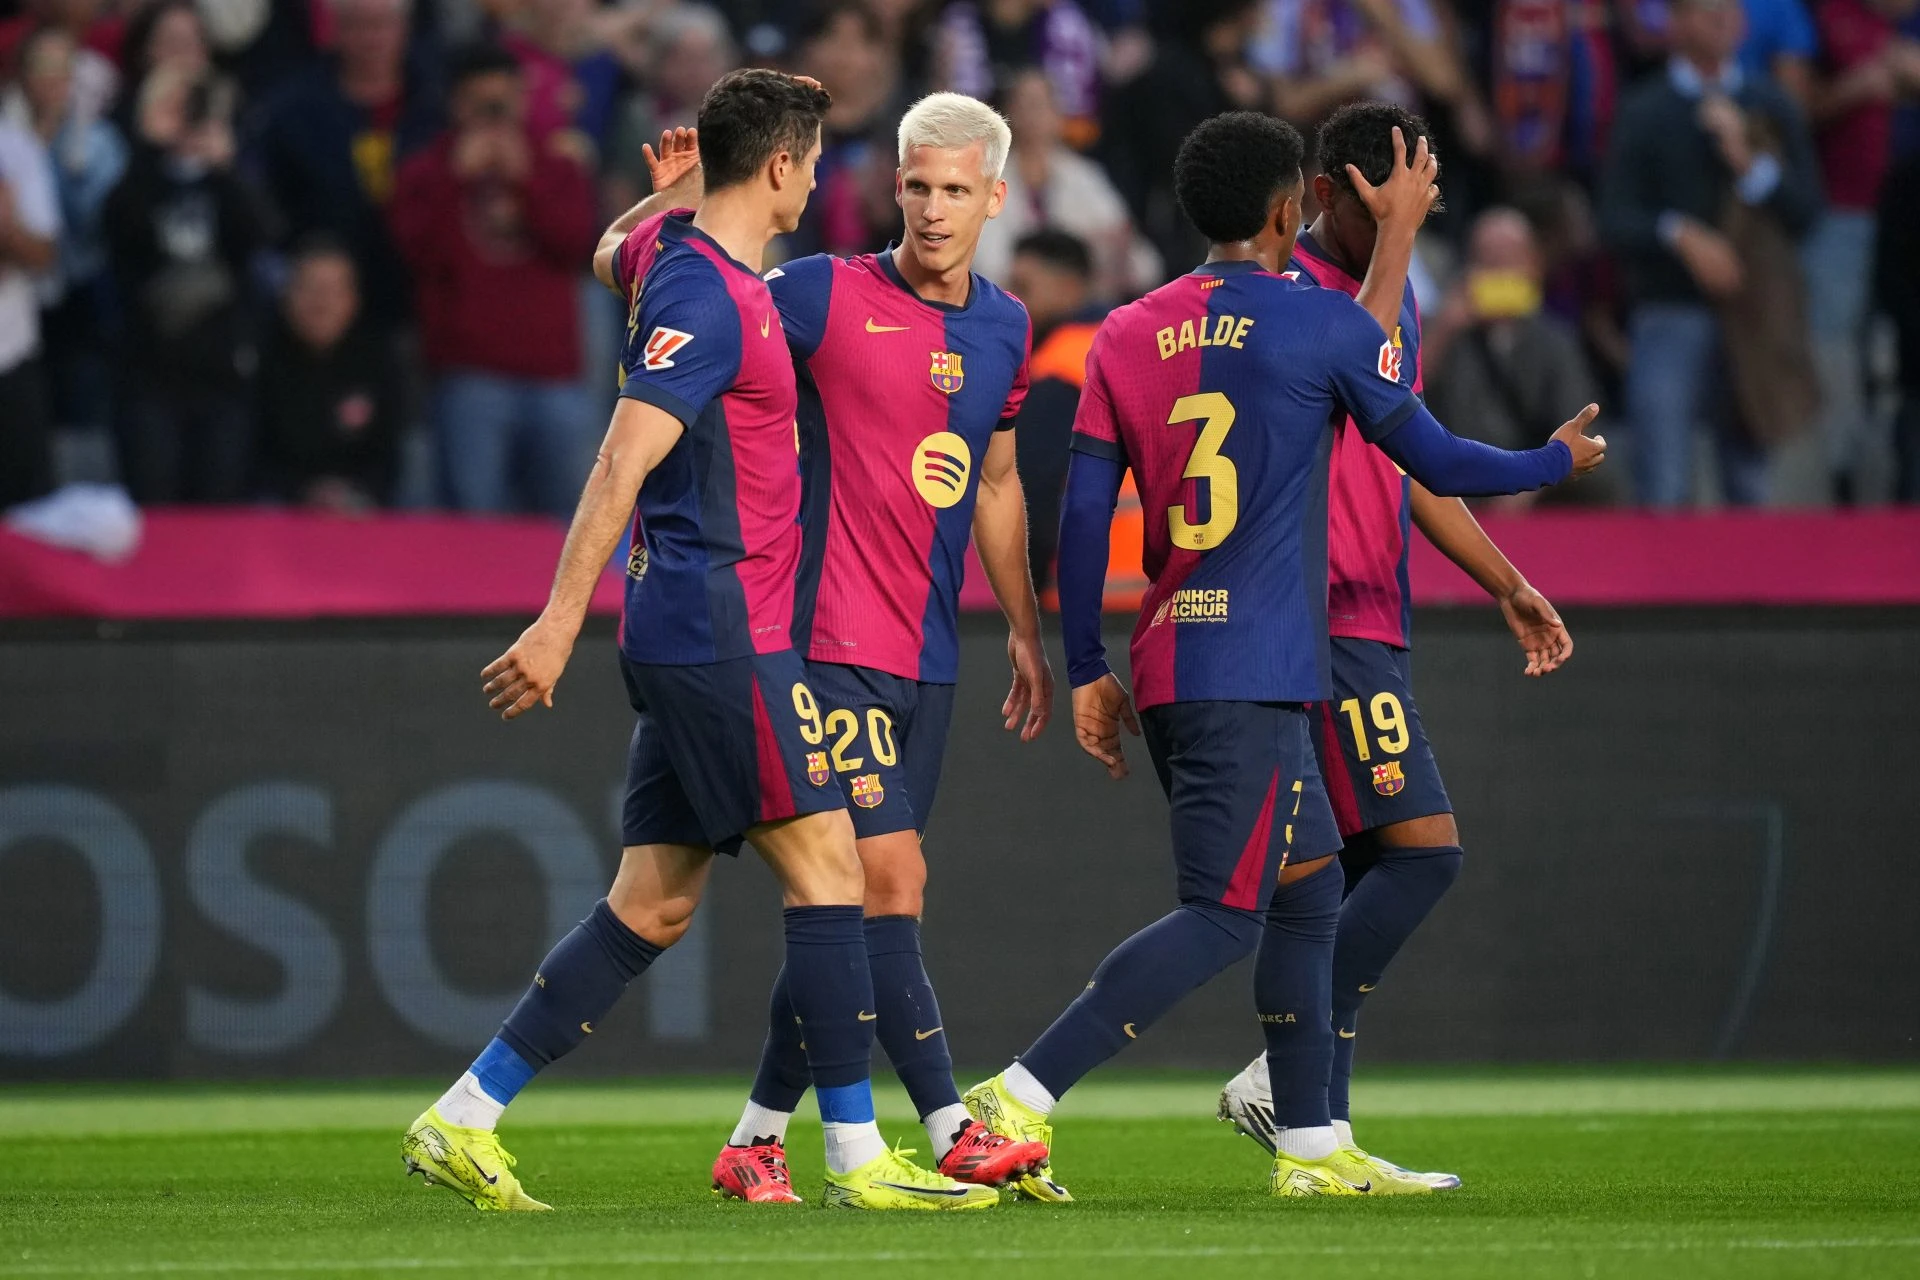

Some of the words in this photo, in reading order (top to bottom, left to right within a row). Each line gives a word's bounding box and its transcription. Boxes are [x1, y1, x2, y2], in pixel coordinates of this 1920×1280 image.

[1156, 315, 1255, 361] BALDE
[1166, 391, 1238, 551] 3
[1170, 603, 1227, 617] ACNUR
[1172, 589, 1228, 603] UNHCR
[791, 682, 823, 745] 9
[825, 708, 897, 773] 20
[1339, 691, 1410, 762] 19
[1257, 1013, 1297, 1024] ARÇA
